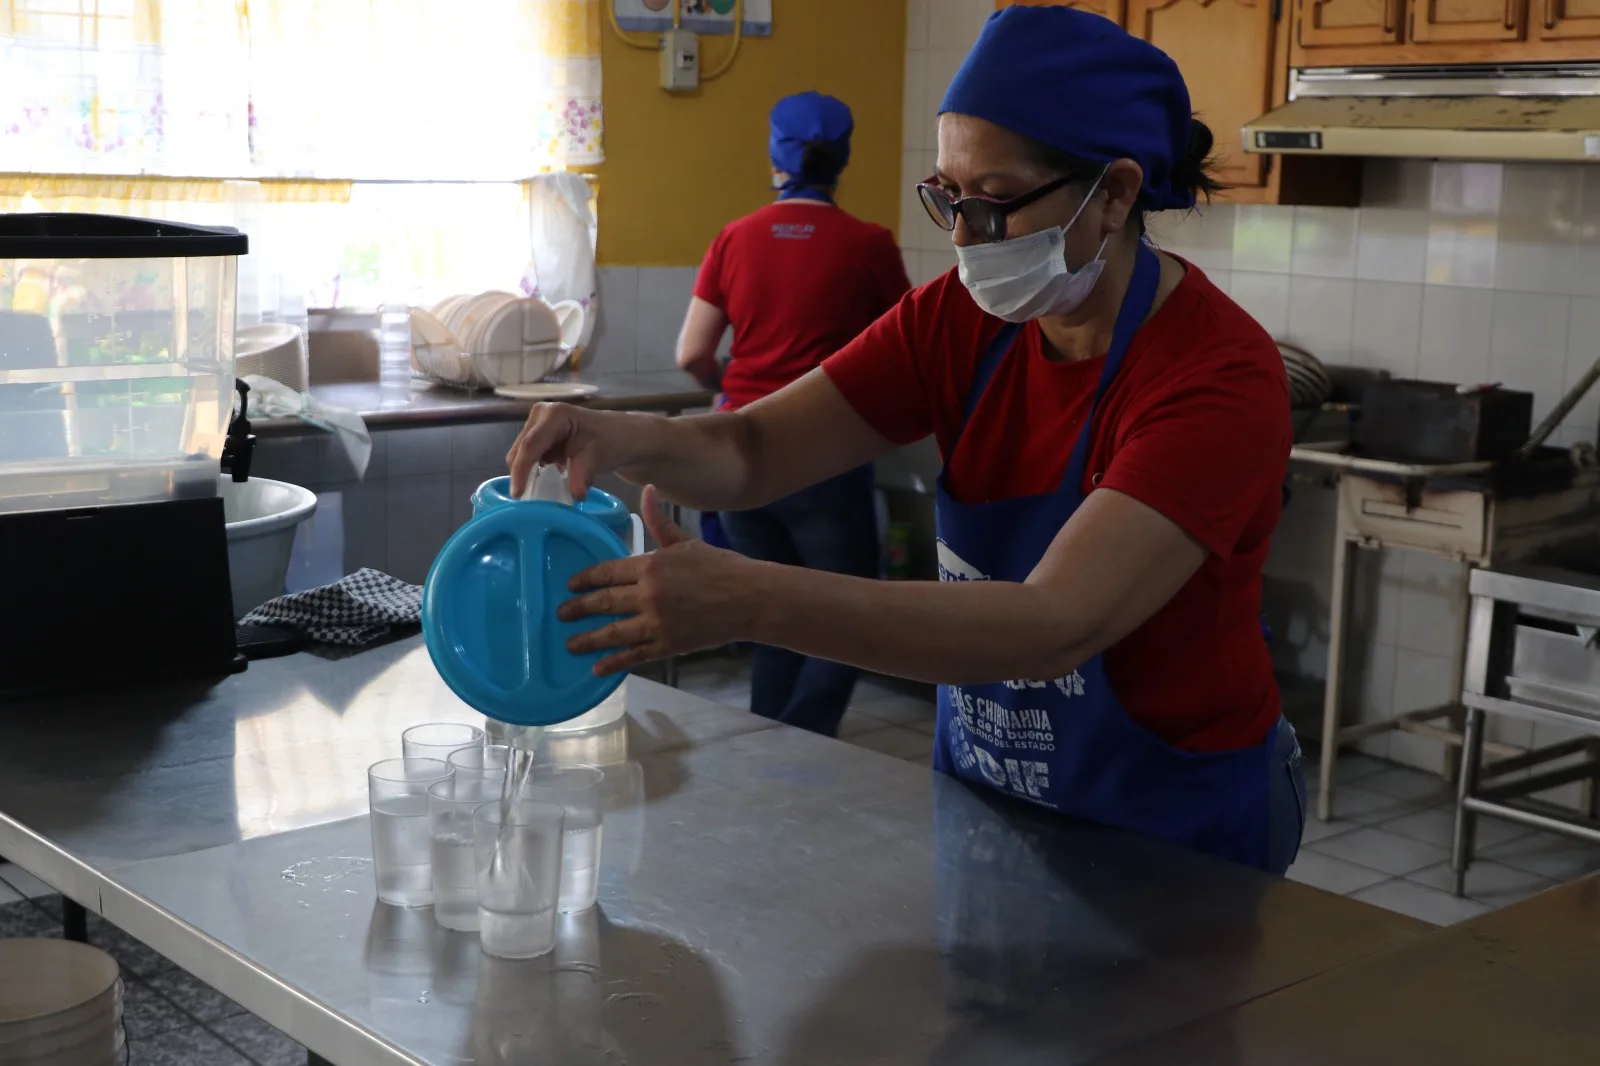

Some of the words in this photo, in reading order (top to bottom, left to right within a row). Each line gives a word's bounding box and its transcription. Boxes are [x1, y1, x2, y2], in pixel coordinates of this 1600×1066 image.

[976, 697, 1052, 731] CHIHUAHUA
[977, 717, 992, 732] de
[994, 723, 1003, 739] lo
[1007, 729, 1055, 742] bueno
[994, 738, 1013, 749] DEL
[1014, 740, 1056, 752] ESTADO
[973, 744, 1050, 798] DIF
